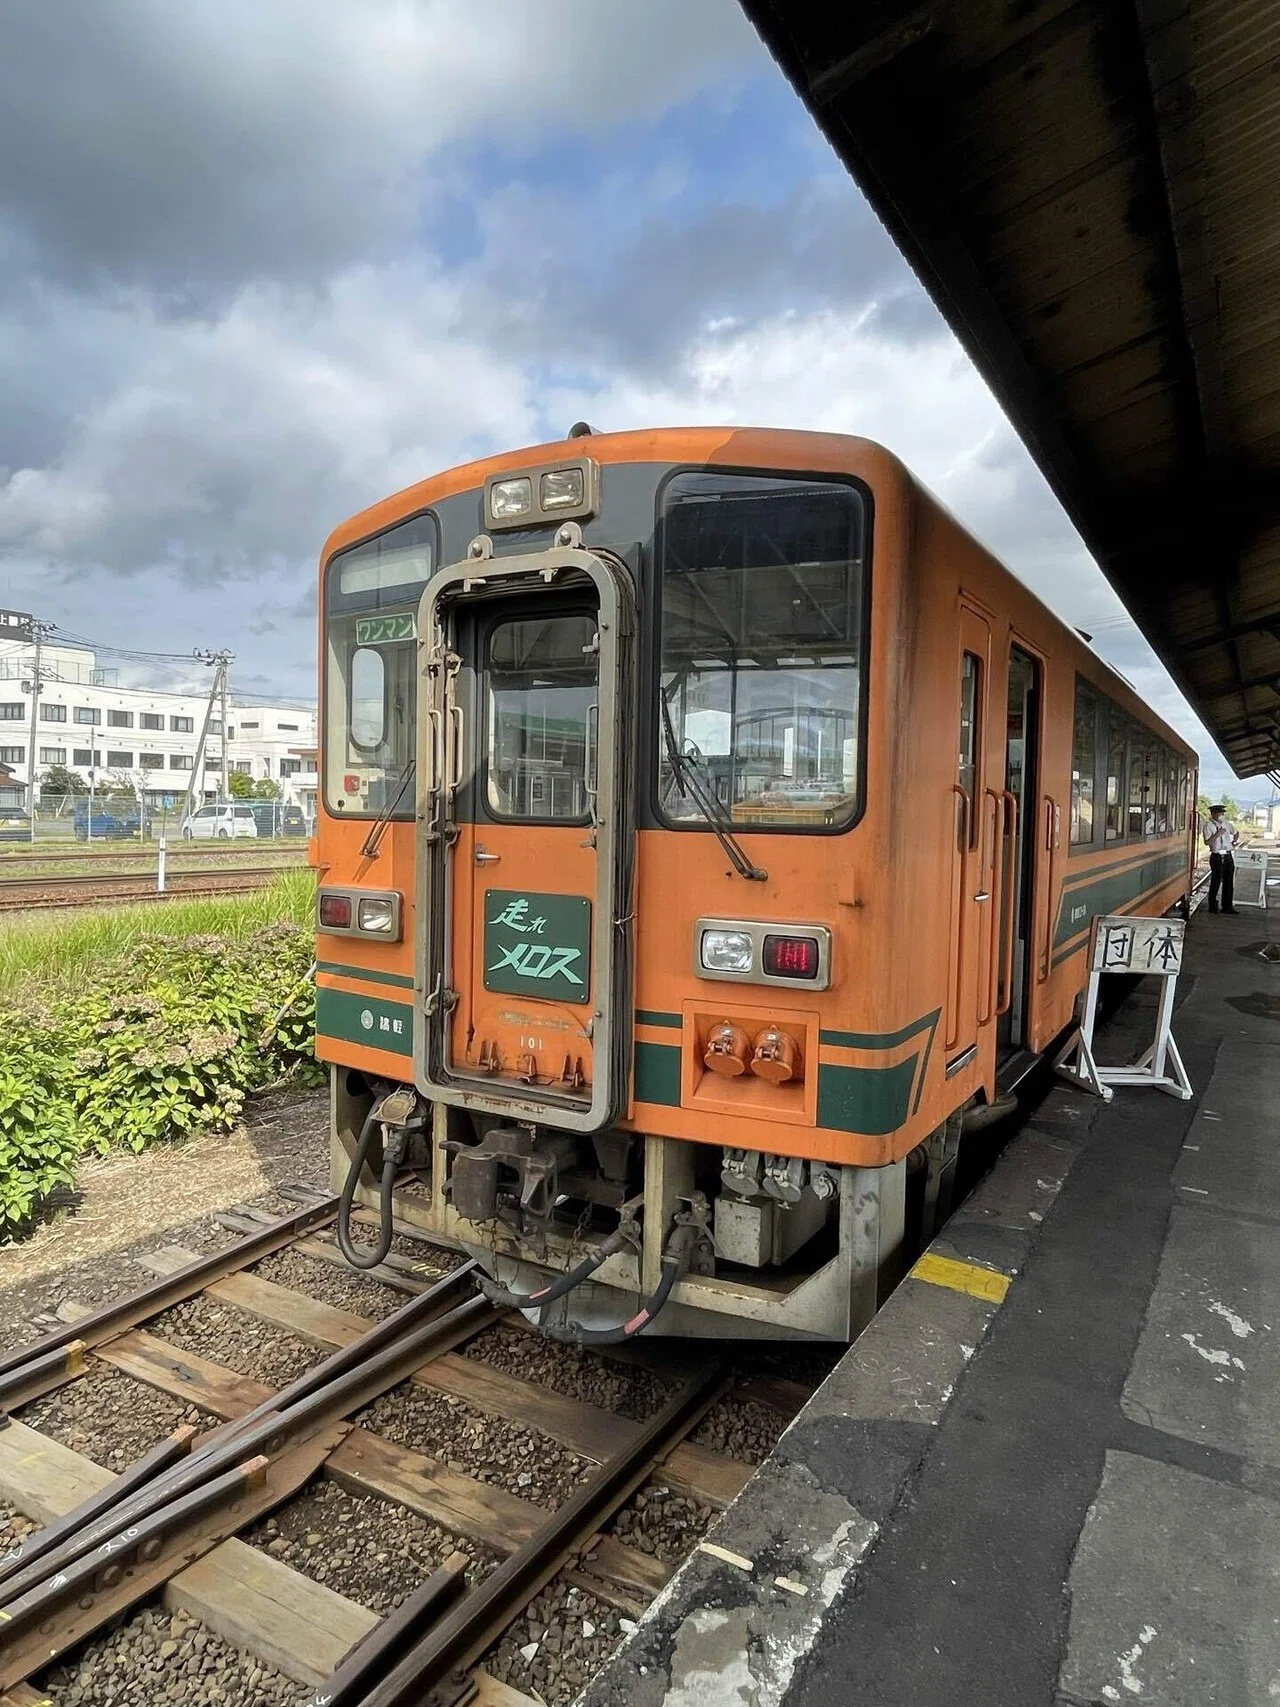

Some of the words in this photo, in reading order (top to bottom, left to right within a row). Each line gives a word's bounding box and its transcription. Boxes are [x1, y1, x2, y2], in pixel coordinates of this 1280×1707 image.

[359, 618, 412, 641] ワンマン
[488, 899, 548, 934] 走れ
[487, 943, 584, 985] メロス
[1102, 924, 1180, 969] 団体
[520, 1035, 542, 1051] 101
